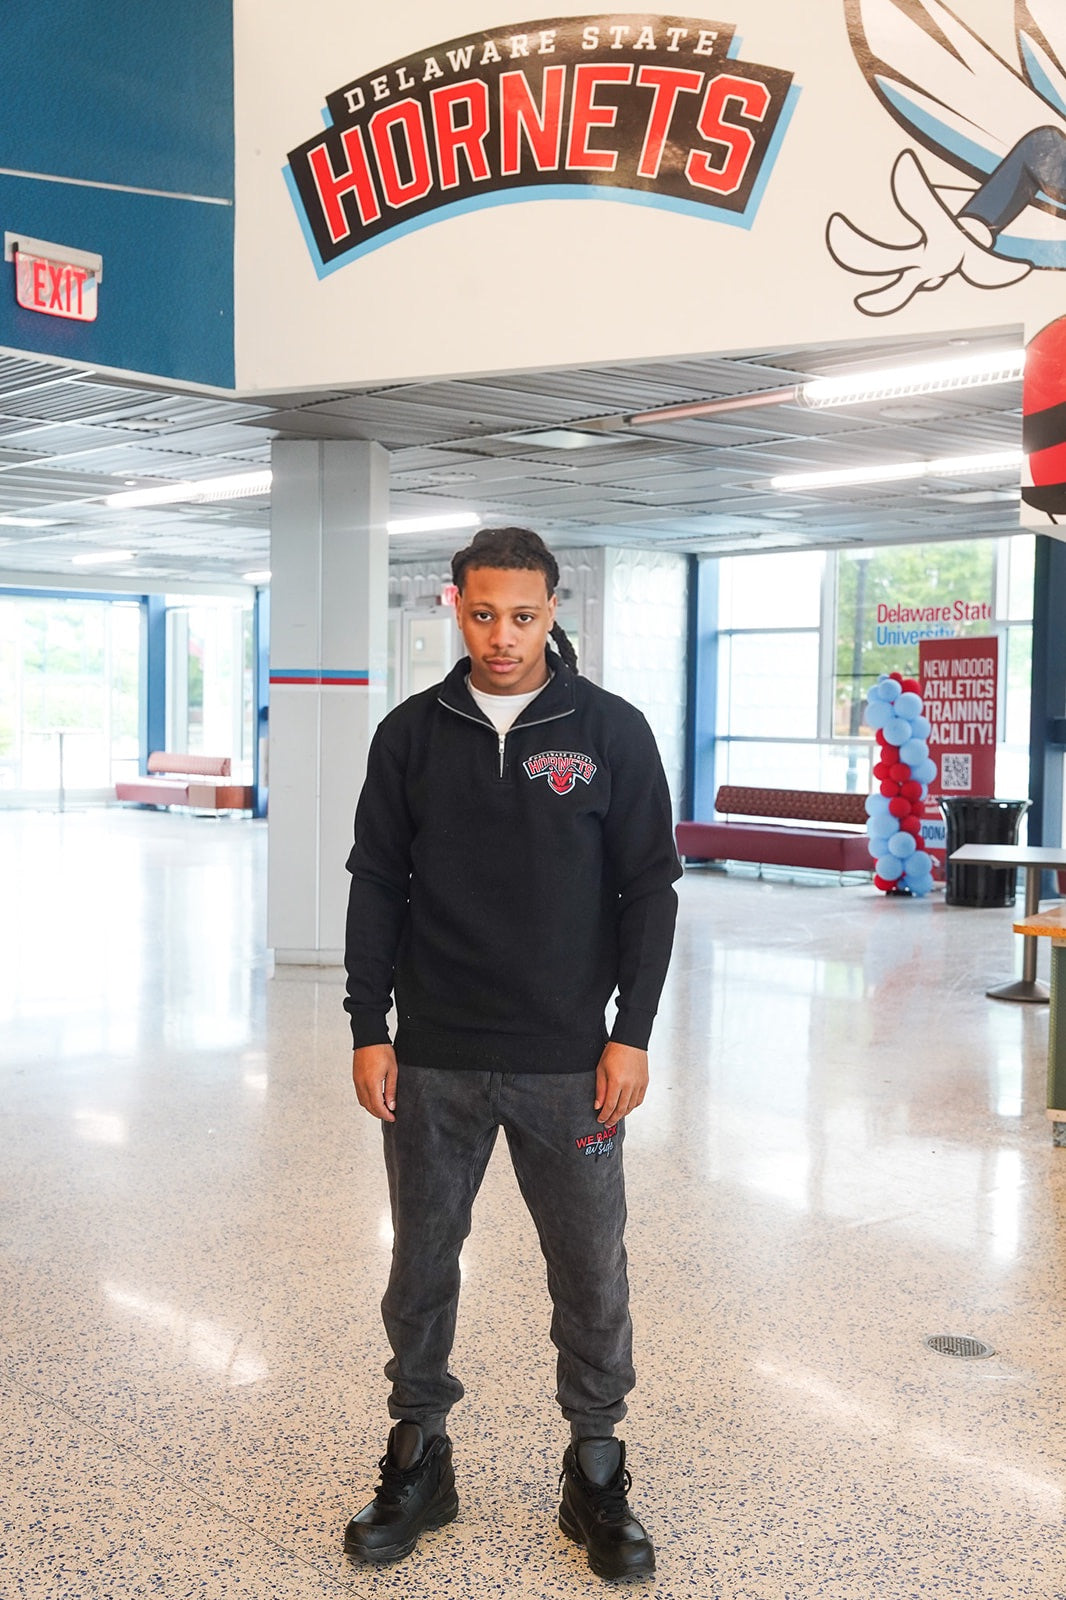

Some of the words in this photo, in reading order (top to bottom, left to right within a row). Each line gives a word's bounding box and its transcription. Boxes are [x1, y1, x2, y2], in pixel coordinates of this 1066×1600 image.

[344, 30, 557, 114] DELAWARE
[582, 25, 718, 57] STATE
[306, 62, 772, 244] HORNETS
[33, 262, 88, 315] EXIT
[877, 602, 951, 624] Delaware
[923, 660, 950, 678] NEW
[951, 658, 994, 677] INDOOR
[923, 679, 994, 699] ATHLETICS
[923, 700, 993, 722] TRAINING
[929, 723, 993, 745] ACILITY!
[528, 757, 594, 780] HORNETS
[575, 1135, 595, 1149] WE
[596, 1125, 617, 1142] BACK
